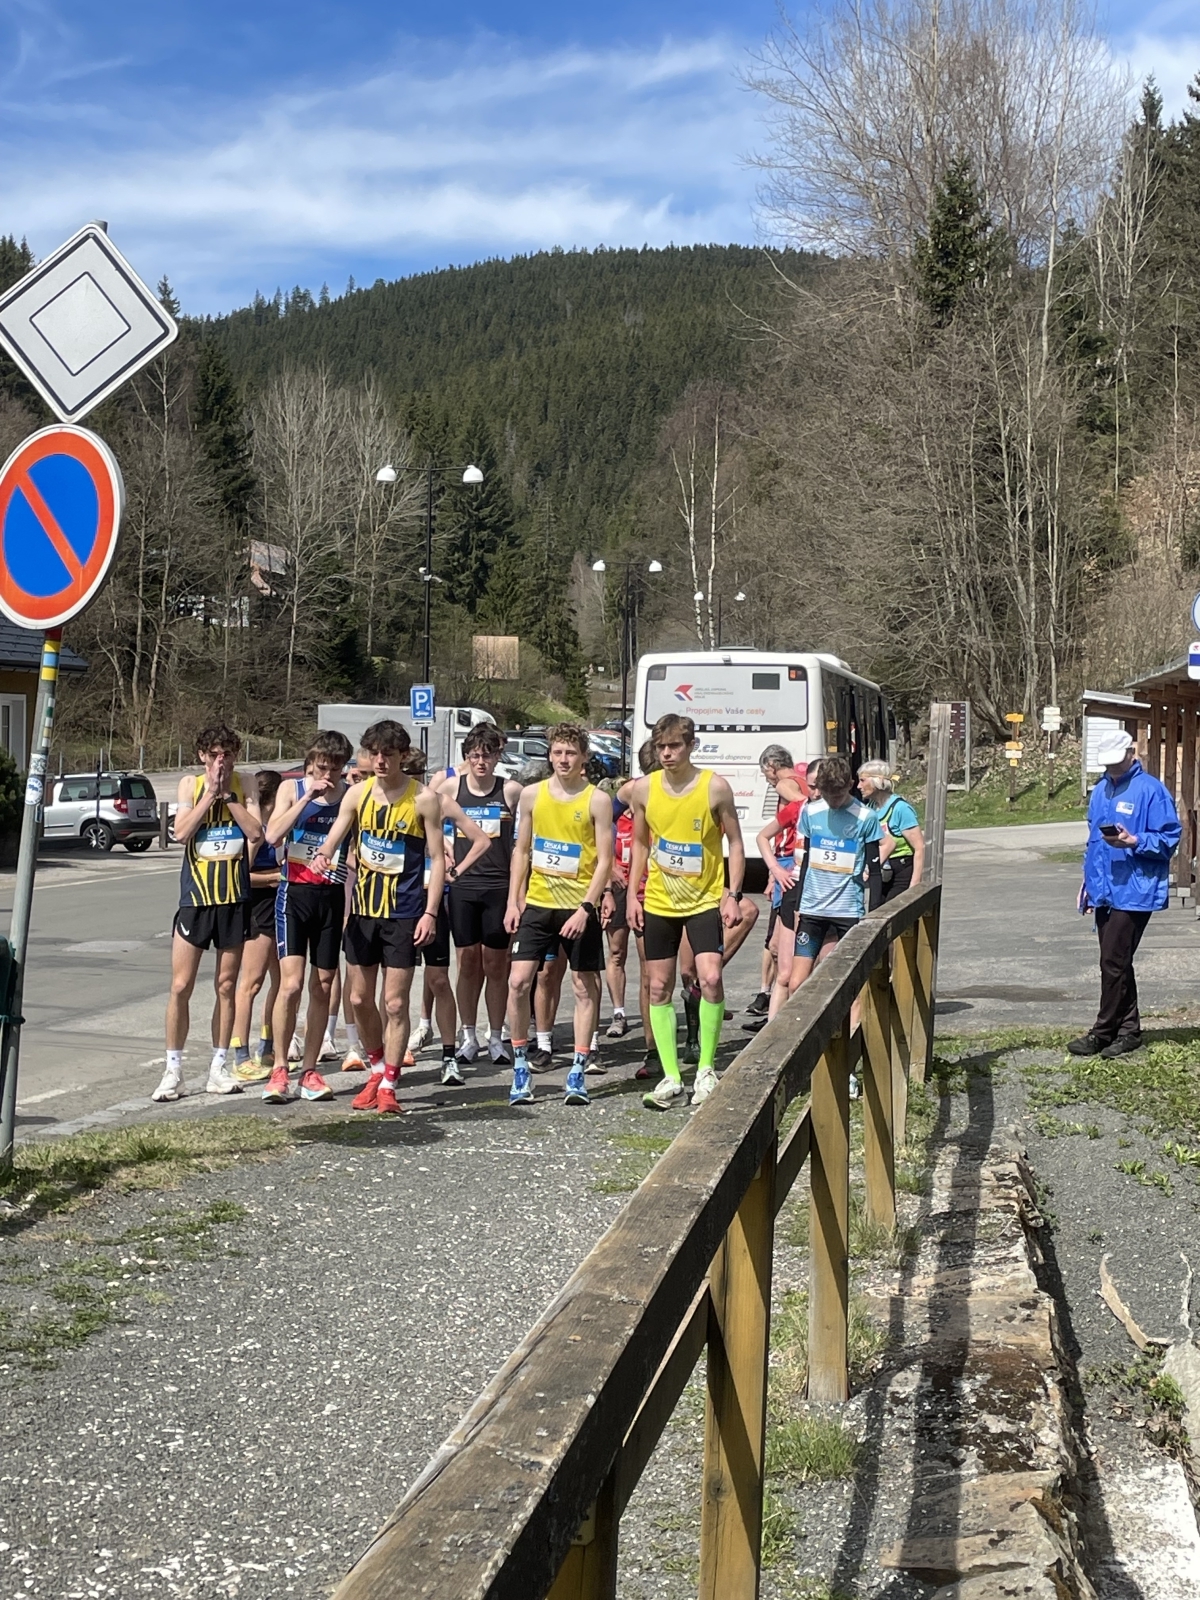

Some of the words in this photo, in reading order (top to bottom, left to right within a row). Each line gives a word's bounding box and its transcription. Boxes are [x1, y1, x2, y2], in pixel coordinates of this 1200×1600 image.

[415, 691, 428, 710] P
[725, 707, 744, 715] Vaše
[746, 708, 765, 716] cesty
[213, 841, 228, 852] 57
[370, 851, 386, 863] 59
[546, 854, 561, 866] 52
[670, 855, 684, 867] 54
[823, 851, 837, 861] 53
